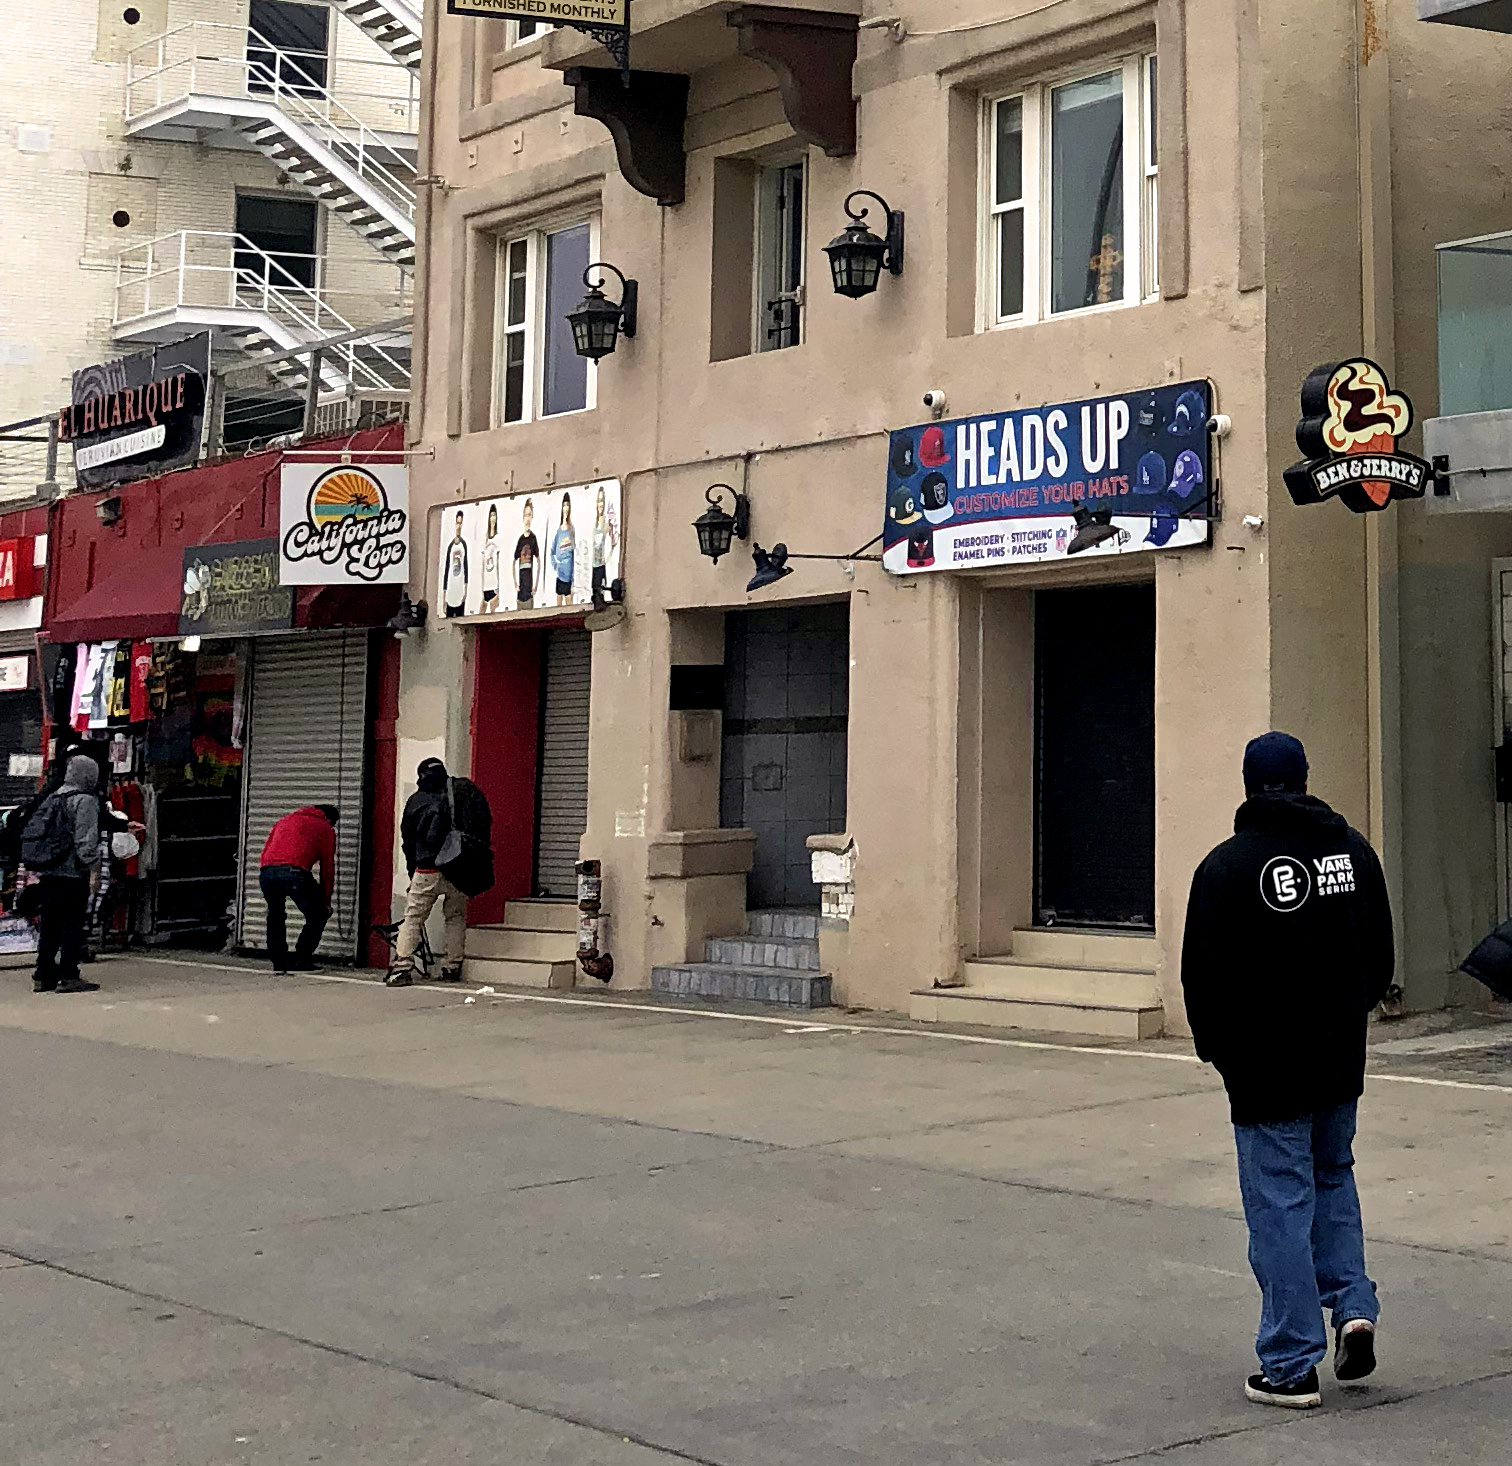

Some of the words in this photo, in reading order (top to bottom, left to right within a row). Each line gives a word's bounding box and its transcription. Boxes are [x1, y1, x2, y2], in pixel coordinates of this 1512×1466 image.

[549, 3, 617, 20] MONTHLY
[59, 405, 79, 439] EL
[82, 373, 186, 433] HUARIQUE
[956, 409, 1069, 488] HEADS
[1081, 400, 1129, 473] UP
[954, 486, 1039, 514] CUSTOMIZE
[1042, 482, 1085, 504] YOUR
[1088, 475, 1129, 498] HATS
[285, 510, 403, 563] California
[954, 534, 1005, 549] EMBROIDERY
[1011, 529, 1053, 543] STITCHING
[347, 536, 404, 580] Love
[953, 548, 984, 561] ENAMEL
[987, 546, 1005, 558] PINS
[1012, 542, 1048, 556] PATCHES
[1313, 854, 1353, 874] VANS
[1317, 871, 1354, 887] PARK
[1318, 882, 1355, 896] SERIES
